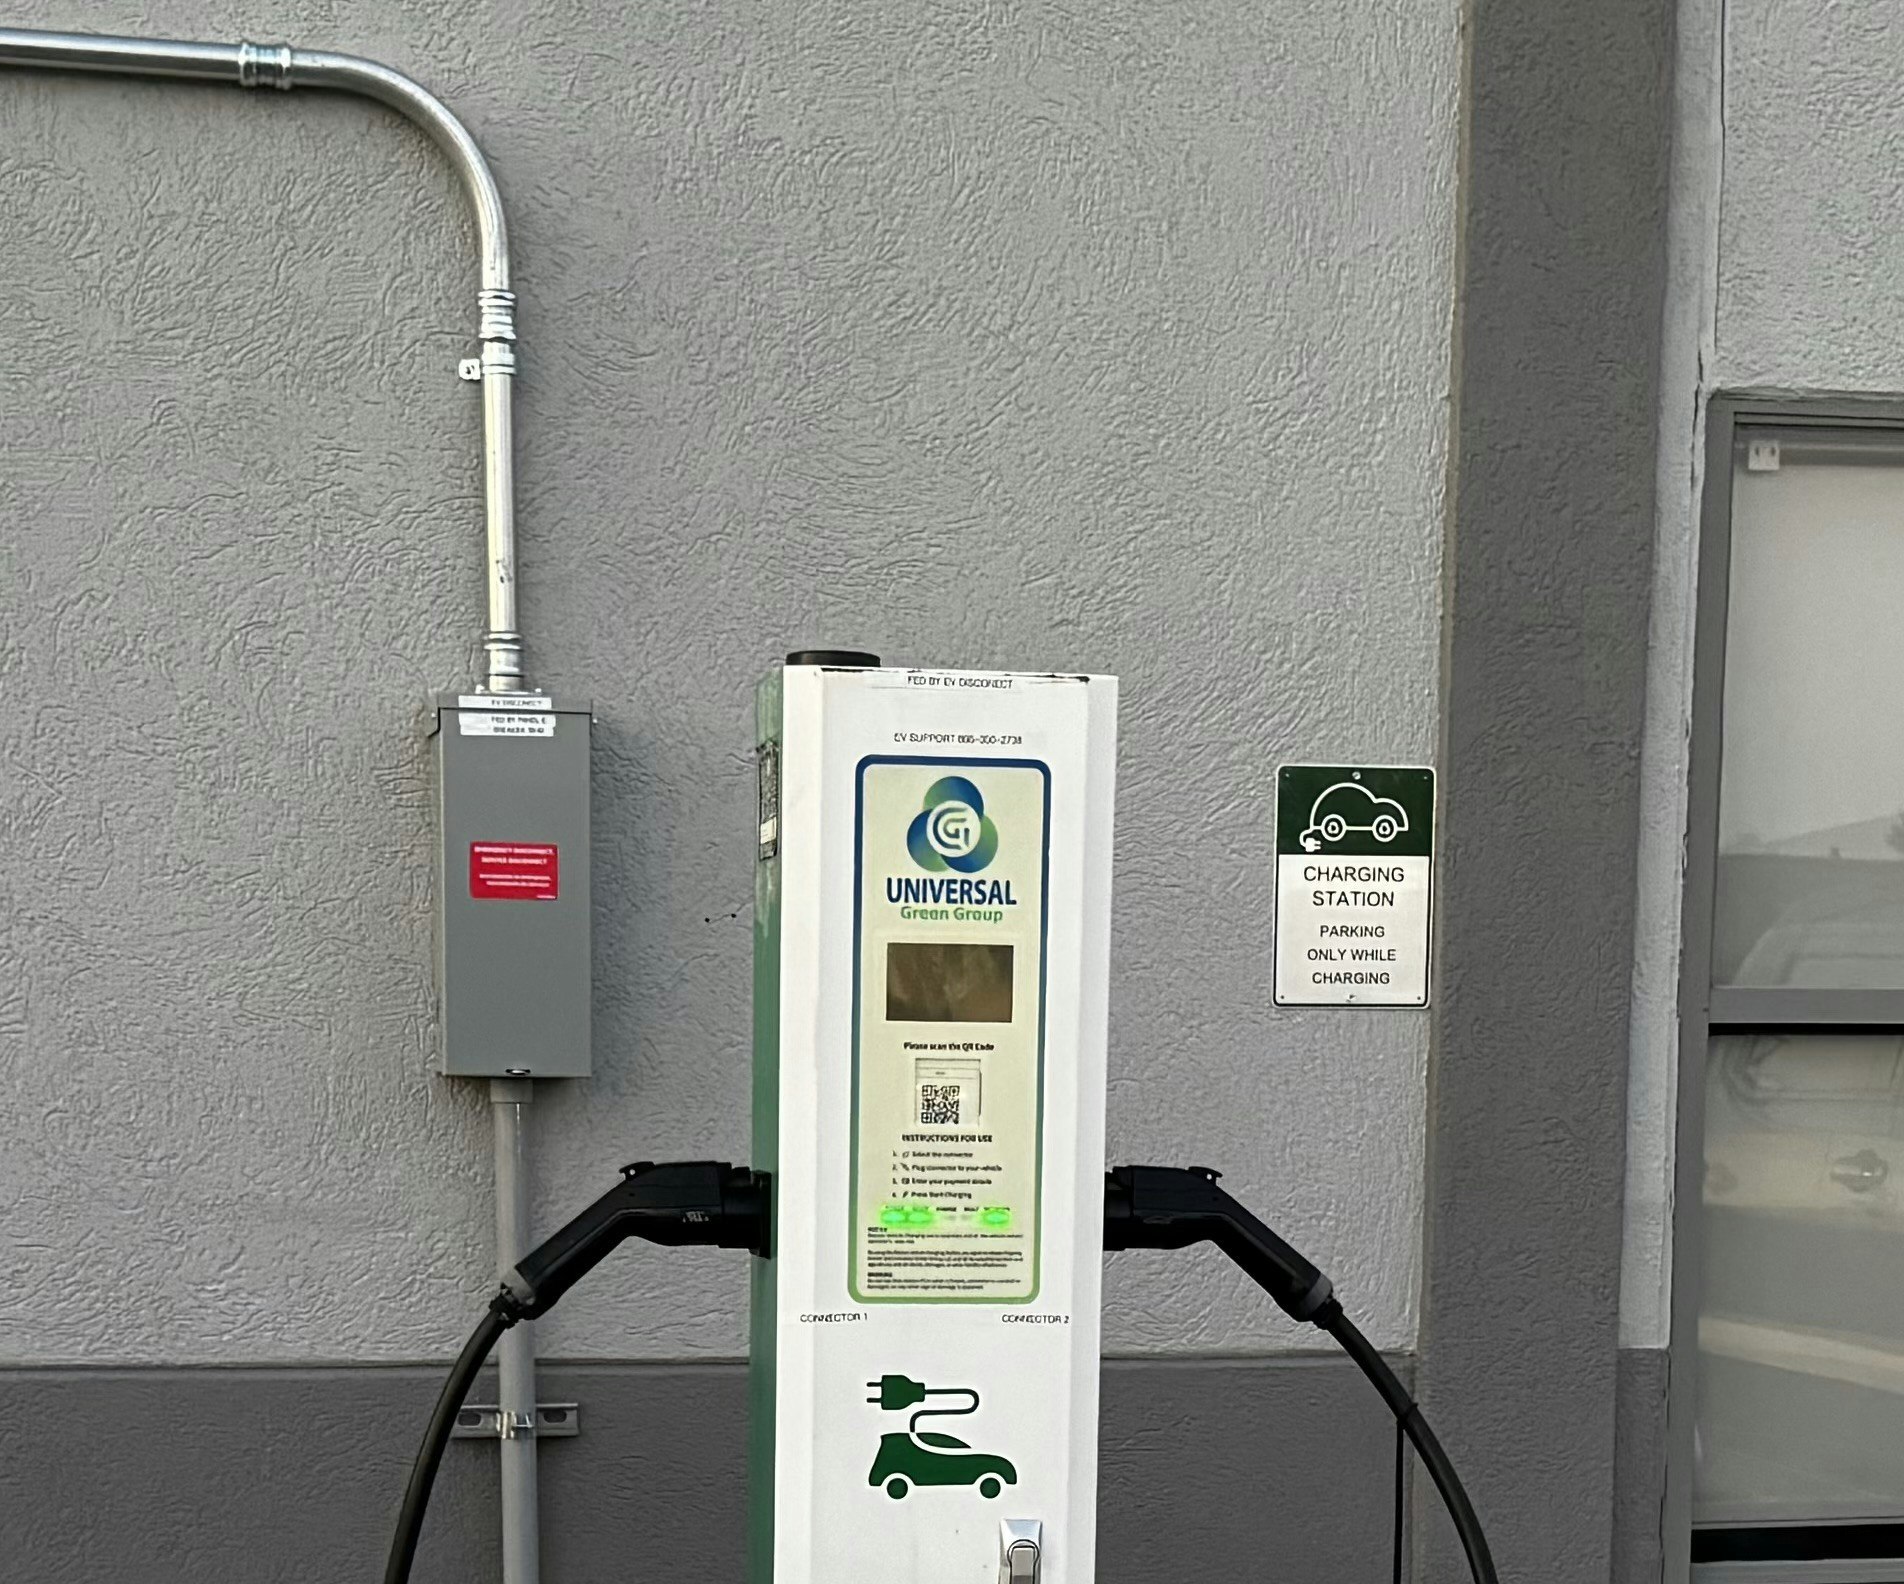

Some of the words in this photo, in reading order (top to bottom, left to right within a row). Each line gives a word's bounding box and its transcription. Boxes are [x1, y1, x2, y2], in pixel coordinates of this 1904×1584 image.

[1304, 866, 1404, 882] CHARGING
[887, 877, 1017, 907] UNIVERSAL
[1313, 891, 1394, 906] STATION
[901, 906, 949, 920] Green
[953, 907, 1003, 924] Group
[1320, 925, 1384, 937] PARKING
[1308, 949, 1346, 961] ONLY
[1351, 949, 1396, 961] WHILE
[1312, 972, 1389, 984] CHARGING
